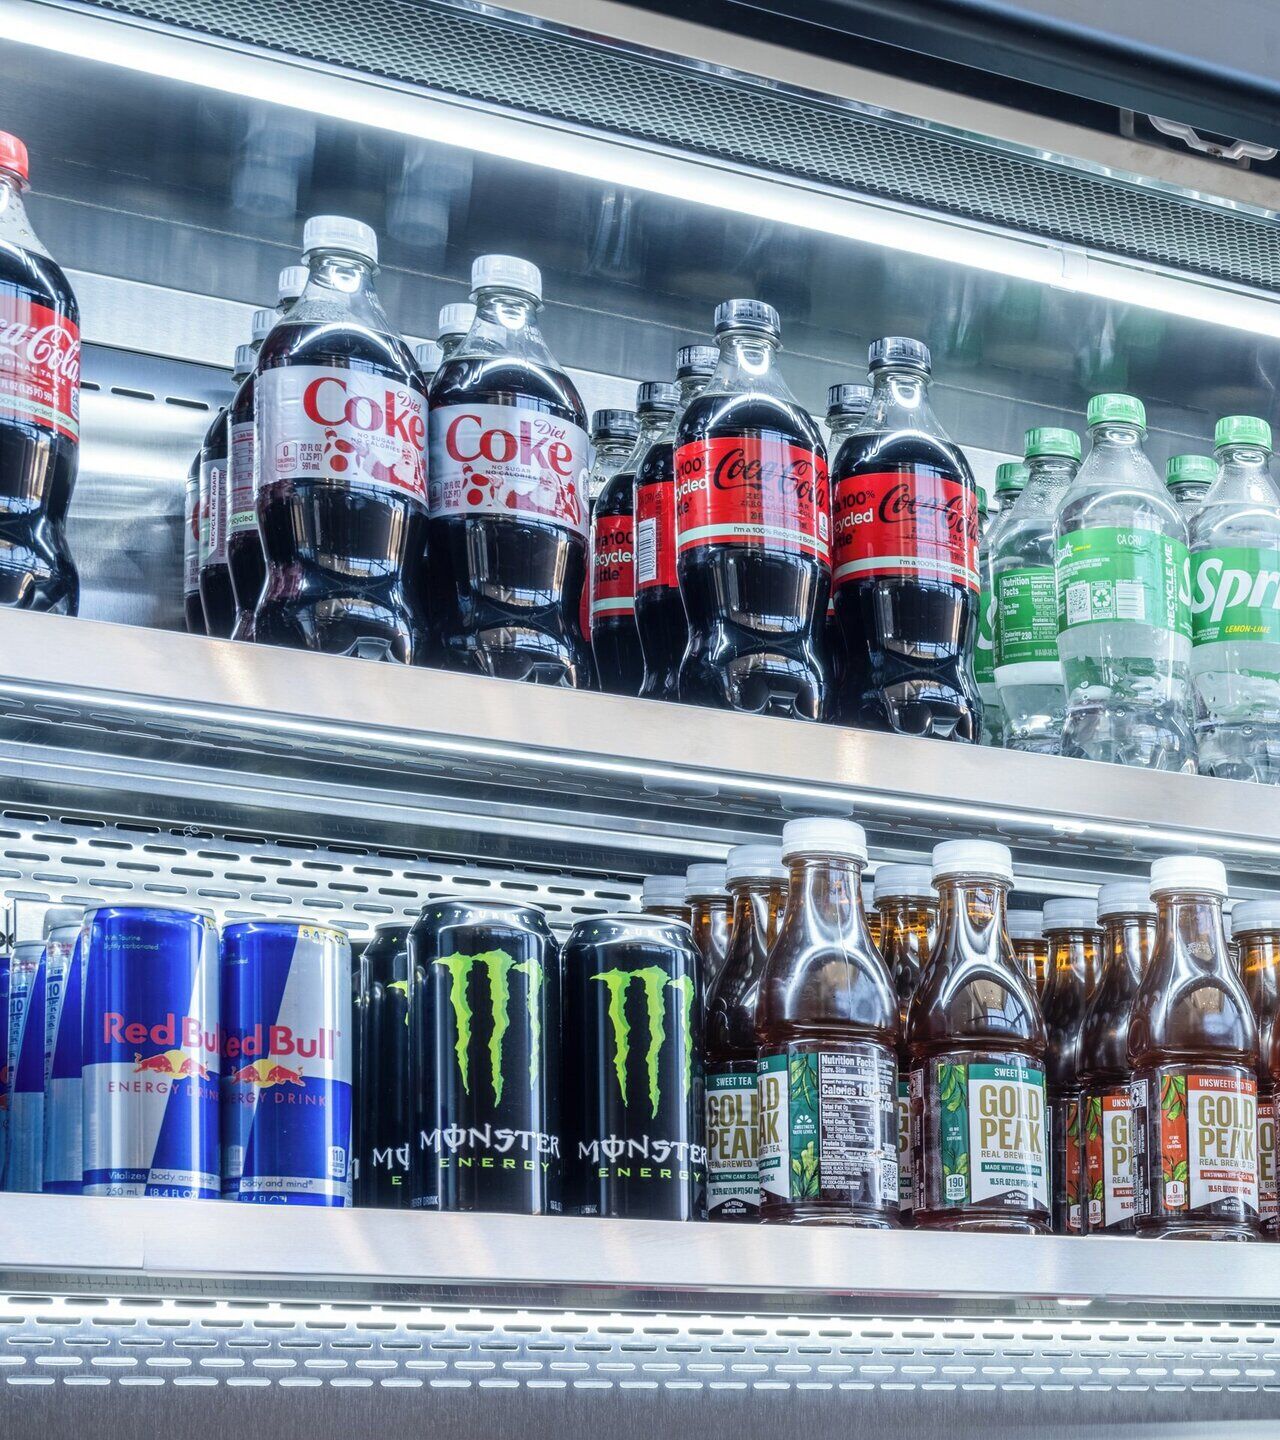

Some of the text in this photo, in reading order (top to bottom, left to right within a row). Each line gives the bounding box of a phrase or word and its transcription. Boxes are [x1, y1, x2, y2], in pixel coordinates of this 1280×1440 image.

[397, 390, 422, 413] Diet
[303, 376, 425, 451] Coke
[533, 419, 567, 440] Diet
[446, 414, 573, 476] Coke
[1167, 570, 1175, 628] RECYCLE
[1225, 625, 1272, 634] LEMON-LIME
[454, 910, 530, 925] TAURINE
[611, 928, 683, 942] TAURINE
[103, 1013, 174, 1045] Red
[269, 1025, 335, 1060] Bull
[822, 1054, 855, 1067] Nutrition
[716, 1076, 734, 1087] SWEET
[994, 1067, 1012, 1078] SWEET
[108, 1081, 179, 1095] ENERGY
[822, 1084, 856, 1096] Calories
[274, 1093, 327, 1107] DRINK
[979, 1084, 1039, 1120] GOLD
[1198, 1095, 1254, 1128] GOLD
[420, 1123, 560, 1160] MONSTER
[979, 1118, 1042, 1153] PEAK
[1199, 1128, 1255, 1159] PEAK
[579, 1135, 708, 1166] MONSTER
[440, 1157, 551, 1173] ENERGY
[598, 1167, 701, 1182] ENERGY
[948, 1178, 964, 1188] 190
